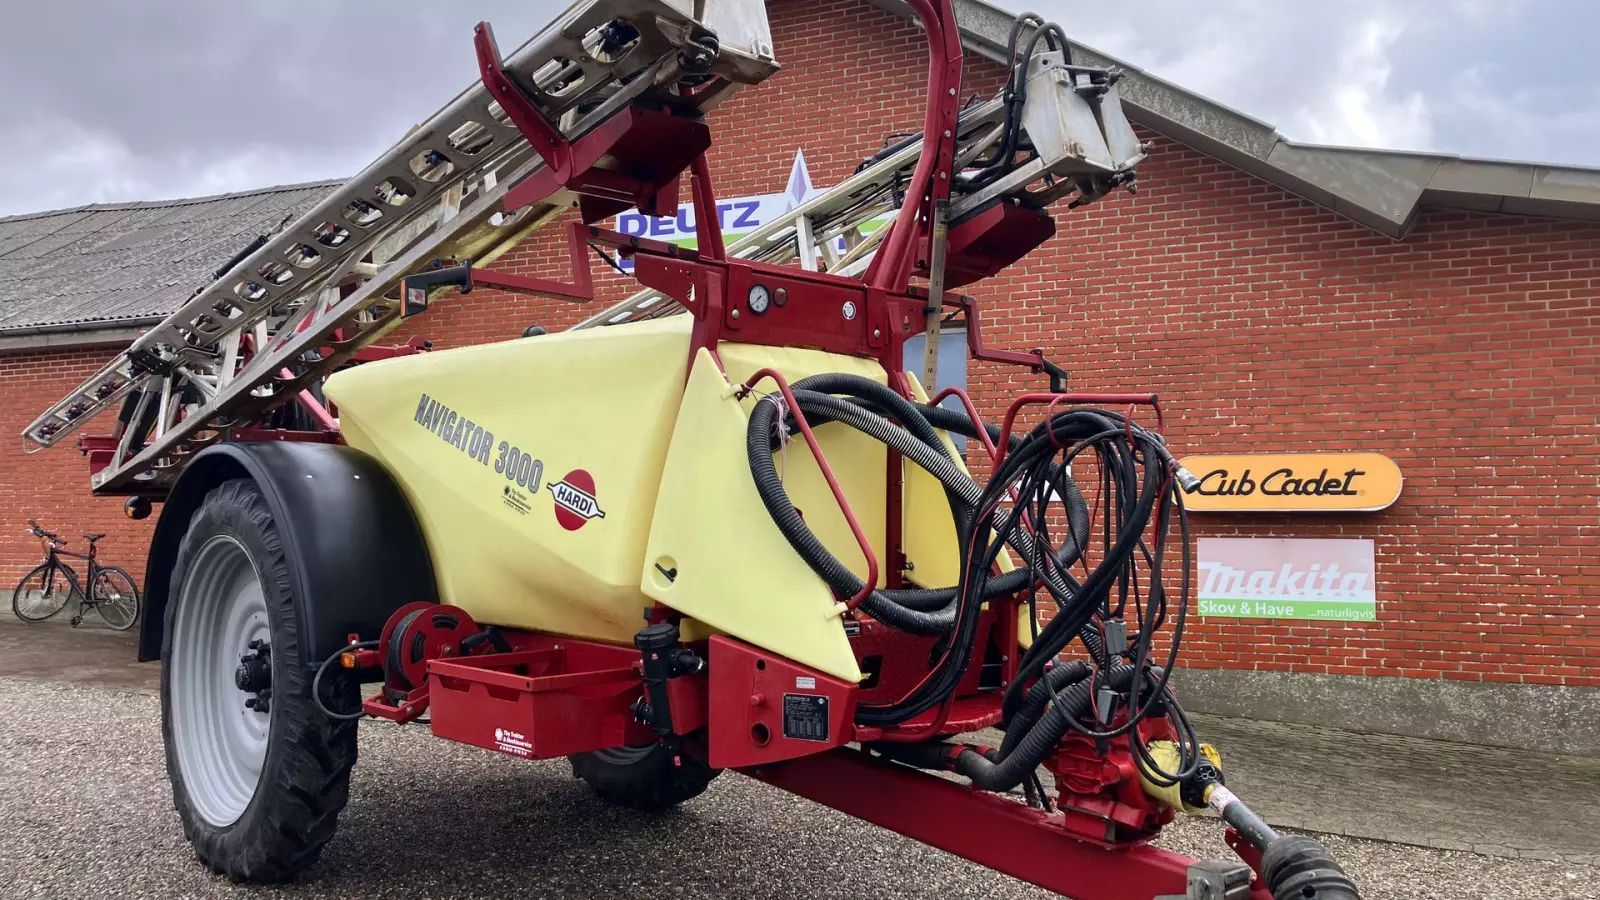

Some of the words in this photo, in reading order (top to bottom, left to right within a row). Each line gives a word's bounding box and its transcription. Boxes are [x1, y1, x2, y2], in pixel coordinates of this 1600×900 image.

[414, 393, 494, 466] NAVIGATOR
[495, 440, 543, 494] 3000
[1199, 469, 1256, 496] Cub
[1260, 468, 1366, 496] Cadet
[556, 485, 593, 515] HARDI
[1200, 601, 1237, 614] Skov
[1240, 602, 1251, 615] &
[1255, 602, 1295, 616] Have
